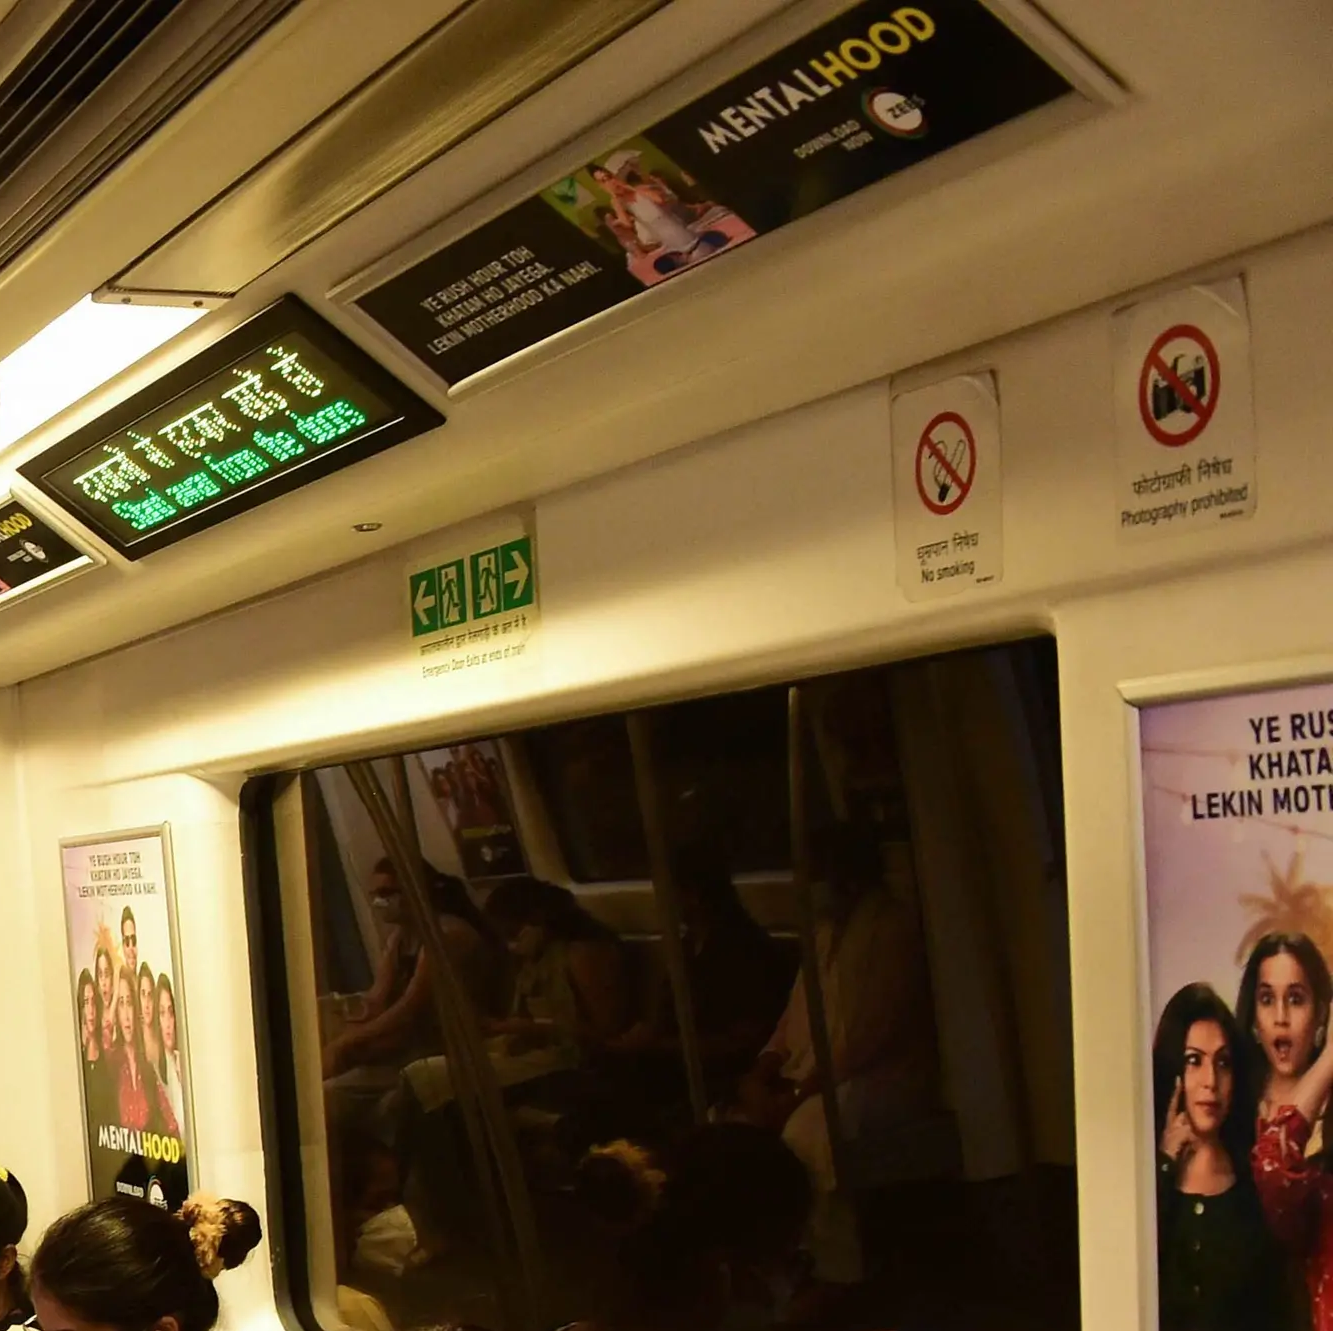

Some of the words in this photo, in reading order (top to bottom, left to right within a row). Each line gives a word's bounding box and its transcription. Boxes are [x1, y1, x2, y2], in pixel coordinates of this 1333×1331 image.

[697, 6, 935, 155] MENTALHOOD
[793, 119, 862, 160] DOWNLOAD
[841, 129, 874, 152] NOW
[419, 296, 443, 313] YE
[438, 279, 474, 306] RUSH
[468, 260, 509, 288] HOUR
[500, 245, 535, 268] TOH
[426, 329, 466, 356] LEKIN
[459, 288, 544, 338] MOTHERHOOD
[538, 277, 566, 297] KA
[434, 294, 487, 329] KHATAM
[479, 285, 505, 304] HO
[203, 449, 270, 484] from
[252, 429, 305, 462] the
[290, 399, 366, 444] doors
[1121, 499, 1188, 528] Photography
[1191, 482, 1248, 517] prohibited
[921, 568, 934, 583] No
[936, 560, 975, 581] smoking
[422, 663, 451, 679] Emergency
[1249, 715, 1281, 744] YE
[1249, 746, 1333, 780] KHATA
[1192, 788, 1263, 820] LEKIN
[98, 1124, 180, 1164] MENTALHOOD
